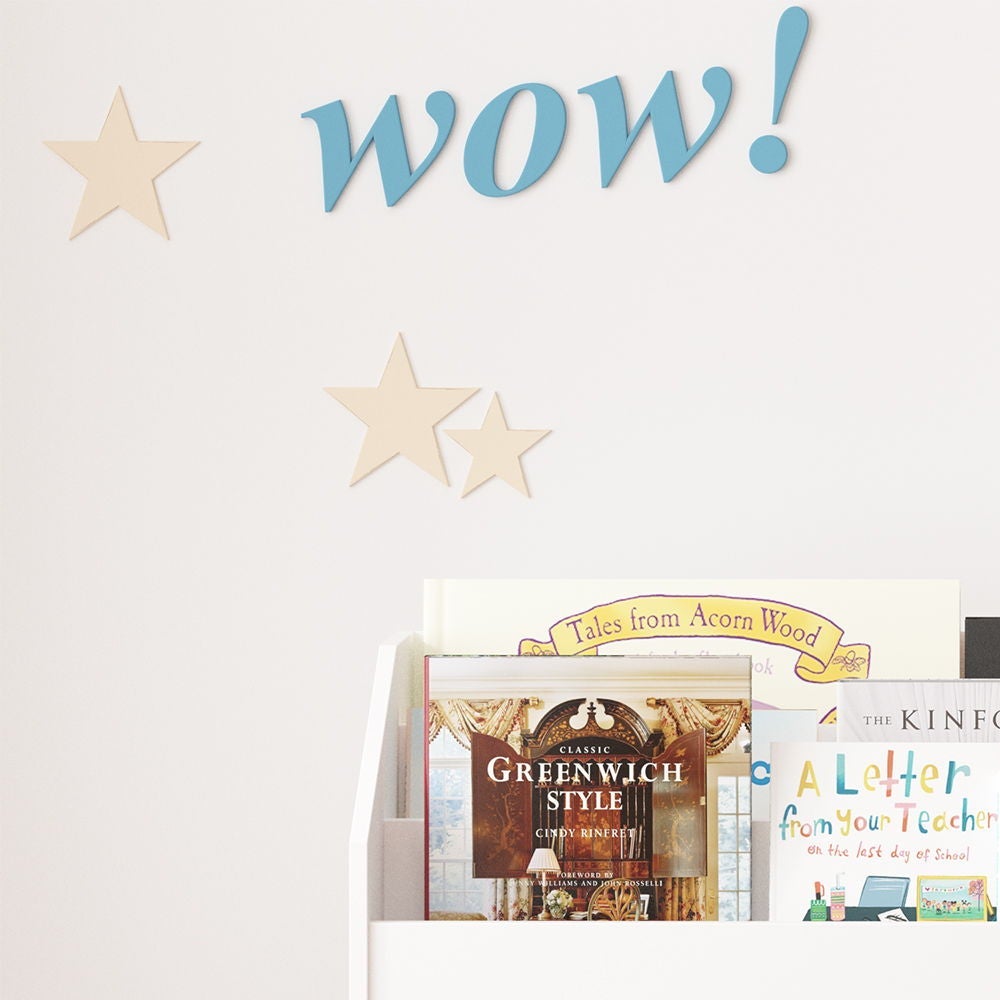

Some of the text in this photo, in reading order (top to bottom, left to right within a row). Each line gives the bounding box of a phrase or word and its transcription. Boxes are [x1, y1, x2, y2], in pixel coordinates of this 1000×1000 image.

[300, 6, 810, 213] wow!
[566, 603, 822, 647] Tales from Acorn Wood
[752, 658, 774, 675] ok
[863, 715, 892, 726] THE
[559, 746, 611, 754] CLASSIC
[486, 756, 683, 783] GREENWICH
[797, 749, 971, 798] A Letter
[547, 790, 623, 811] STYLE
[778, 803, 833, 841] from
[894, 797, 999, 834] Teacher
[535, 828, 635, 839] CINDY RINFRET
[827, 843, 849, 858] the
[856, 840, 884, 859] last
[890, 844, 911, 864] day
[916, 848, 931, 862] of
[556, 871, 614, 879] FOREWORD BY
[581, 879, 598, 888] AND
[600, 879, 624, 888] JOHN
[625, 879, 663, 888] ROSSELLI
